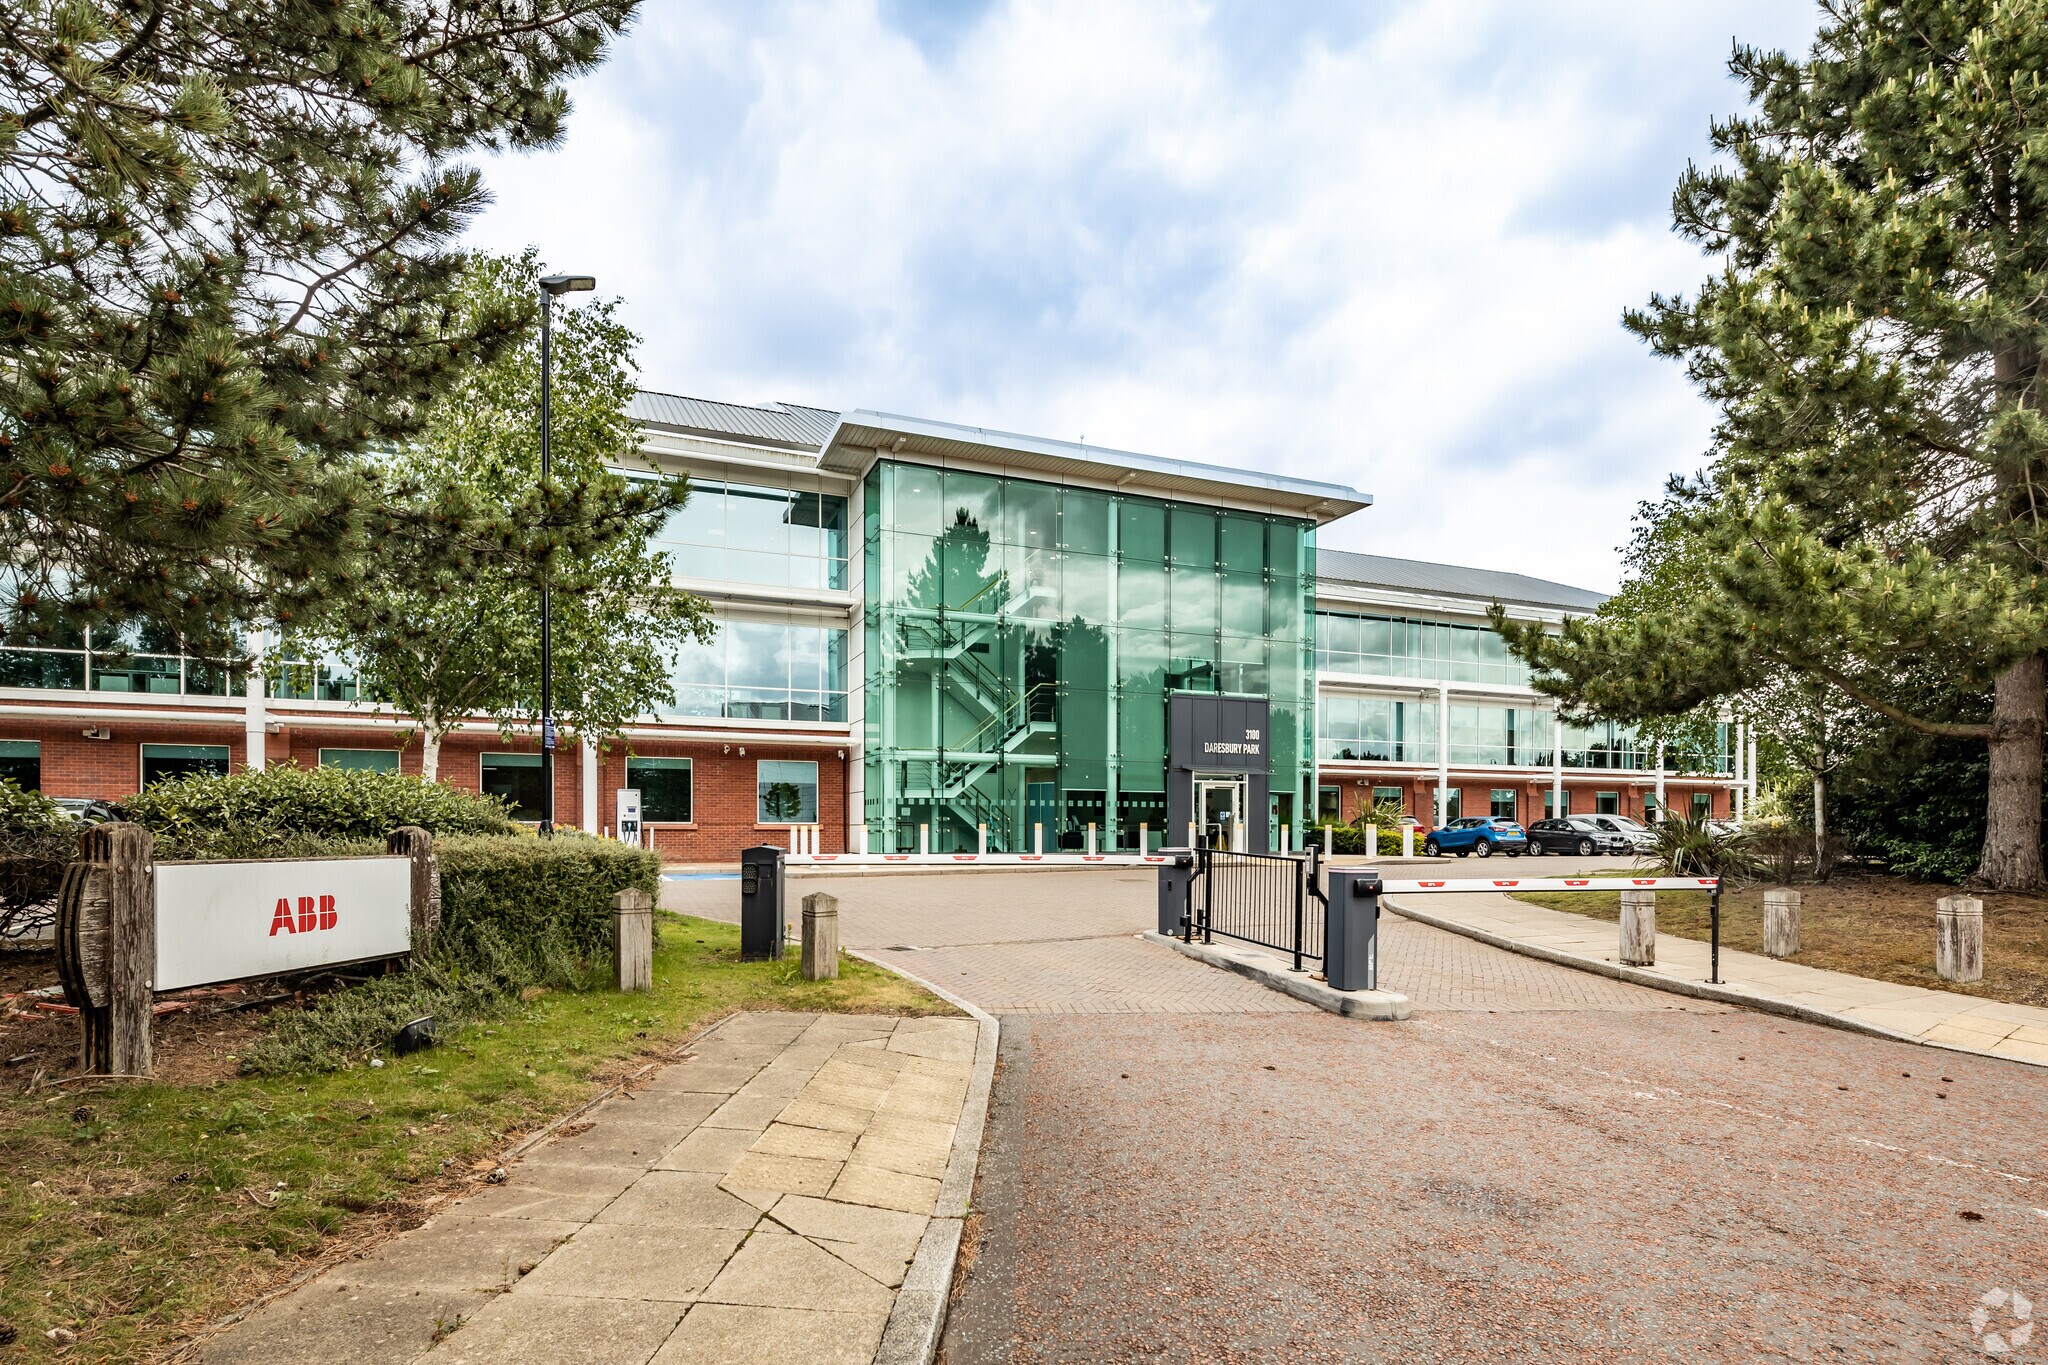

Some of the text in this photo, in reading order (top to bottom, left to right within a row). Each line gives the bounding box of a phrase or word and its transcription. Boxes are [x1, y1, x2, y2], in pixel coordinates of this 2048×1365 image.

[1245, 729, 1260, 740] 3100
[1204, 742, 1260, 755] DARESBURY PARK
[268, 894, 338, 937] ABB
